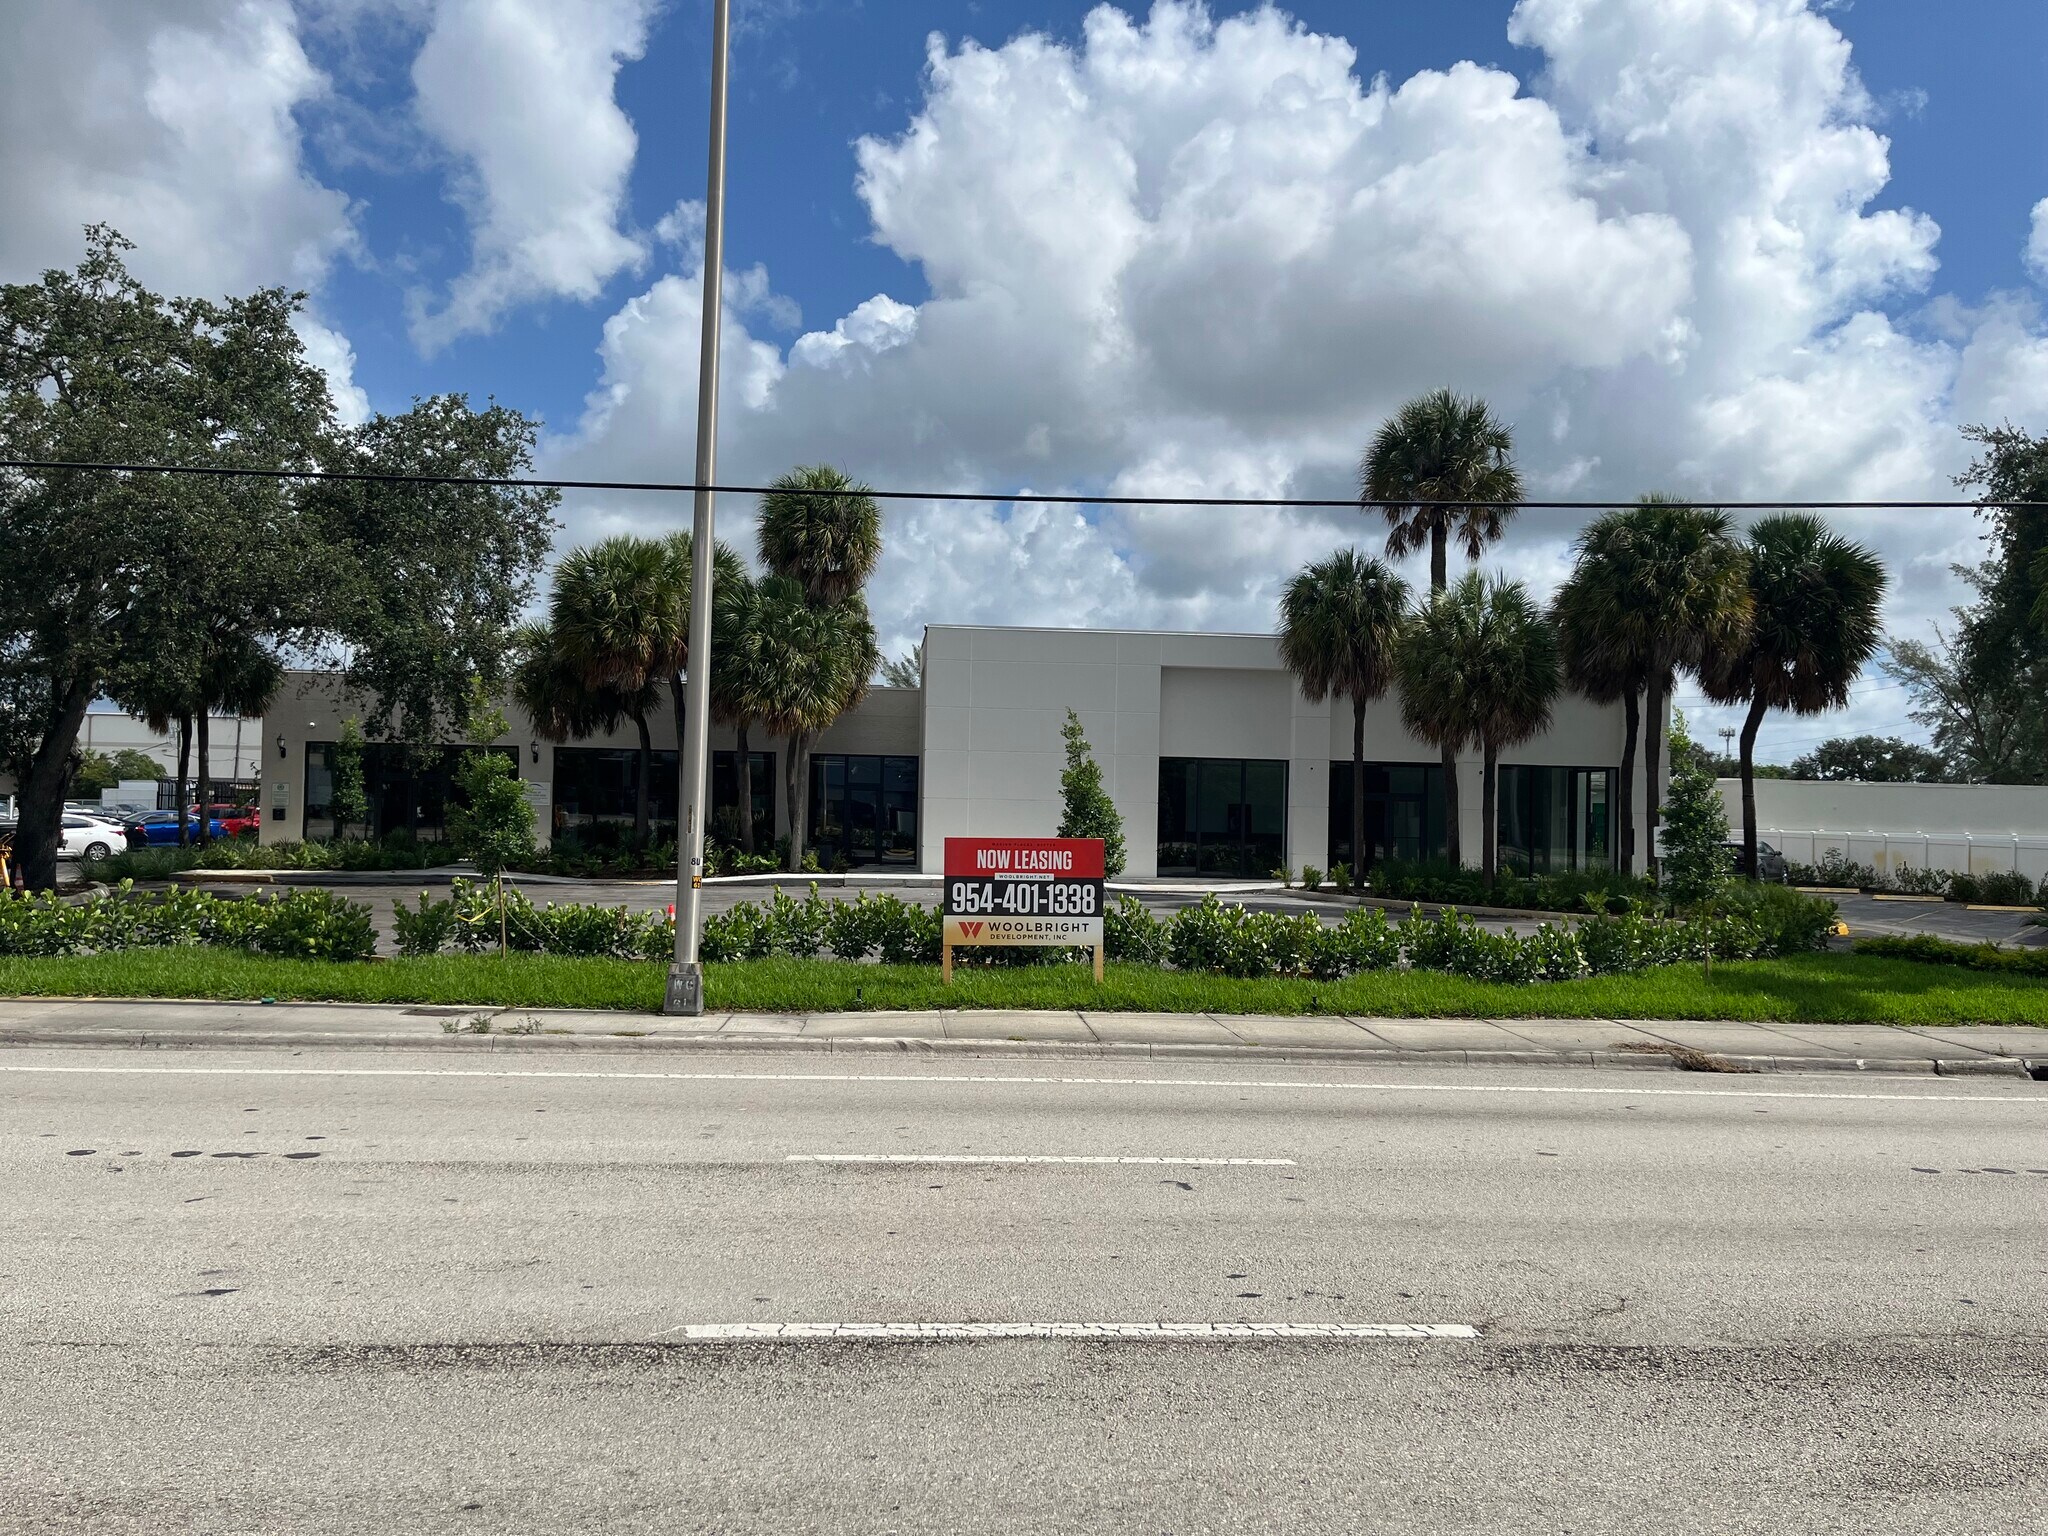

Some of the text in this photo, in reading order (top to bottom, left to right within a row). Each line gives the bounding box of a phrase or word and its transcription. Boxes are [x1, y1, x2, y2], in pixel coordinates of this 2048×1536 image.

[976, 849, 1073, 871] NOW LEASING
[951, 882, 1096, 914] 954-401-1338
[988, 921, 1090, 933] WOOLBRIGHT
